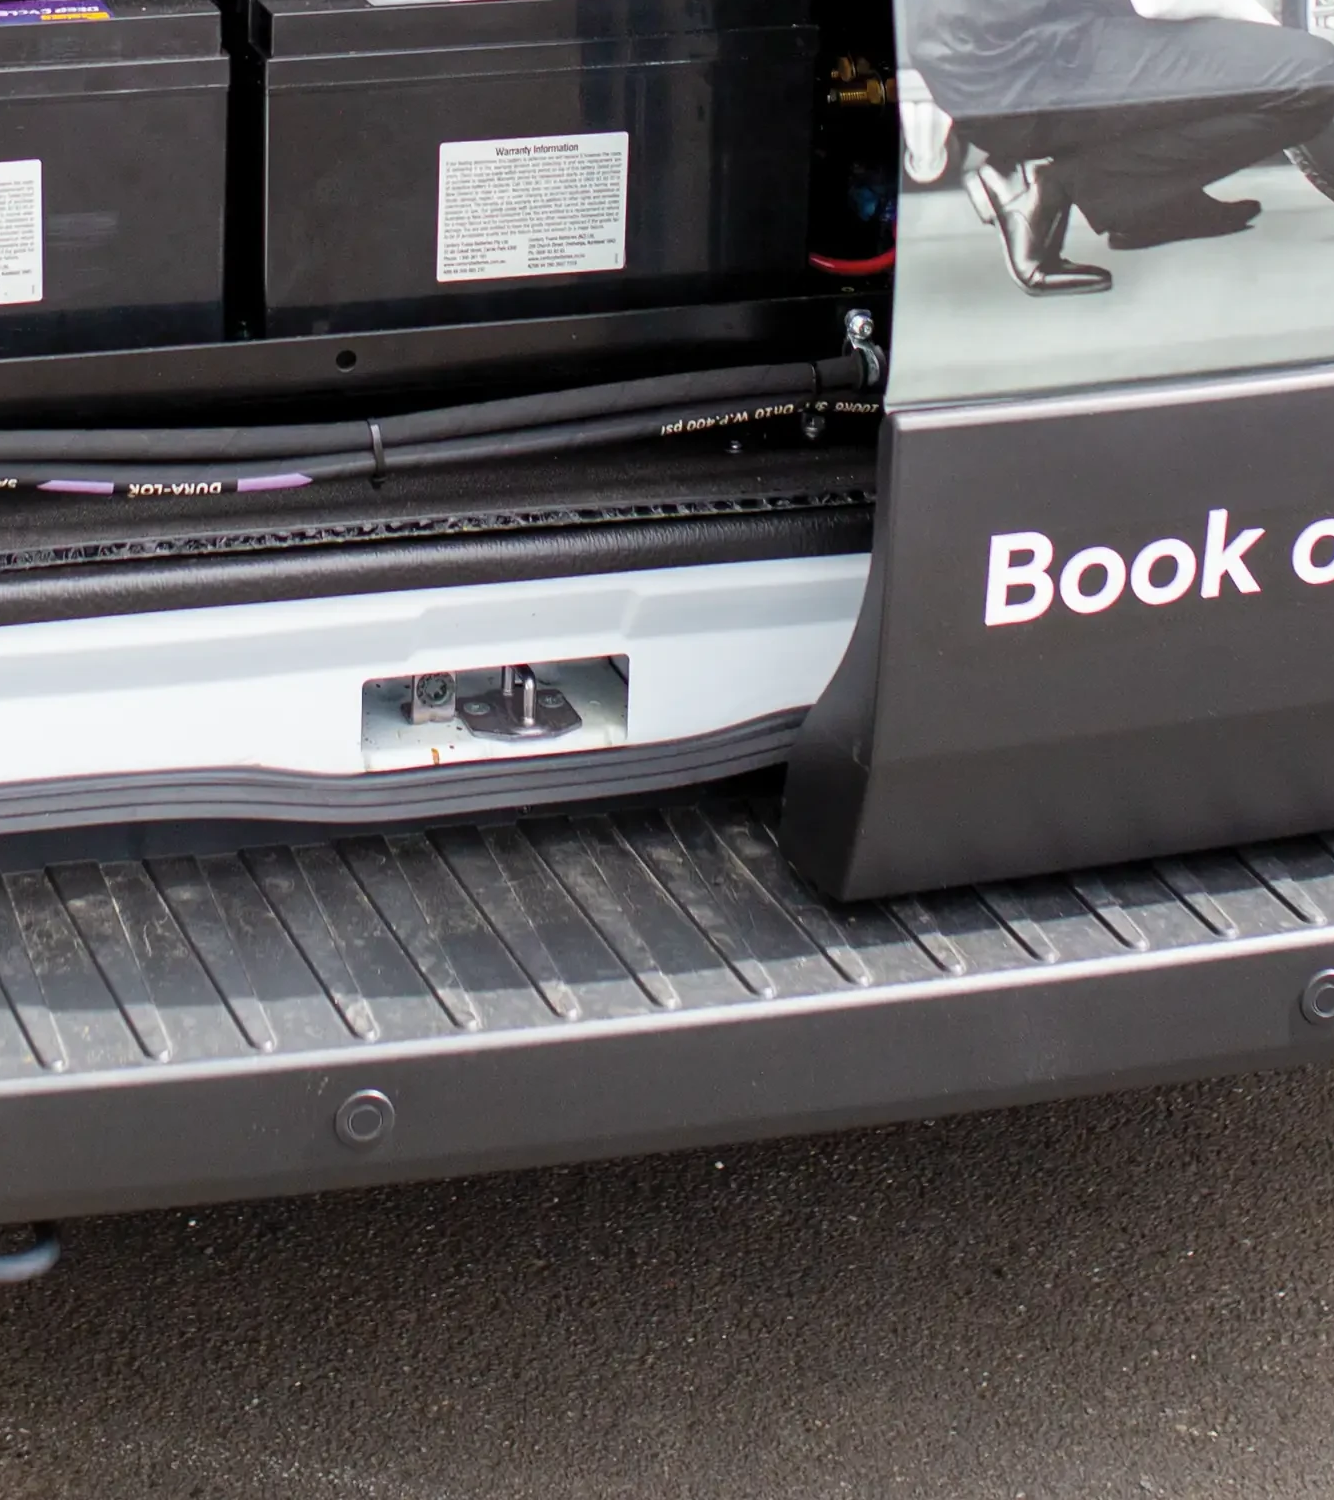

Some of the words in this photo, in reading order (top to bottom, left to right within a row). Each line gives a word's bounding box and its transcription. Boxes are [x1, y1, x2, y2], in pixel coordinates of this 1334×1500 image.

[495, 145, 532, 156] Warranty
[533, 143, 579, 155] Information
[128, 481, 222, 498] DURA-LOK
[984, 508, 1266, 627] Book
